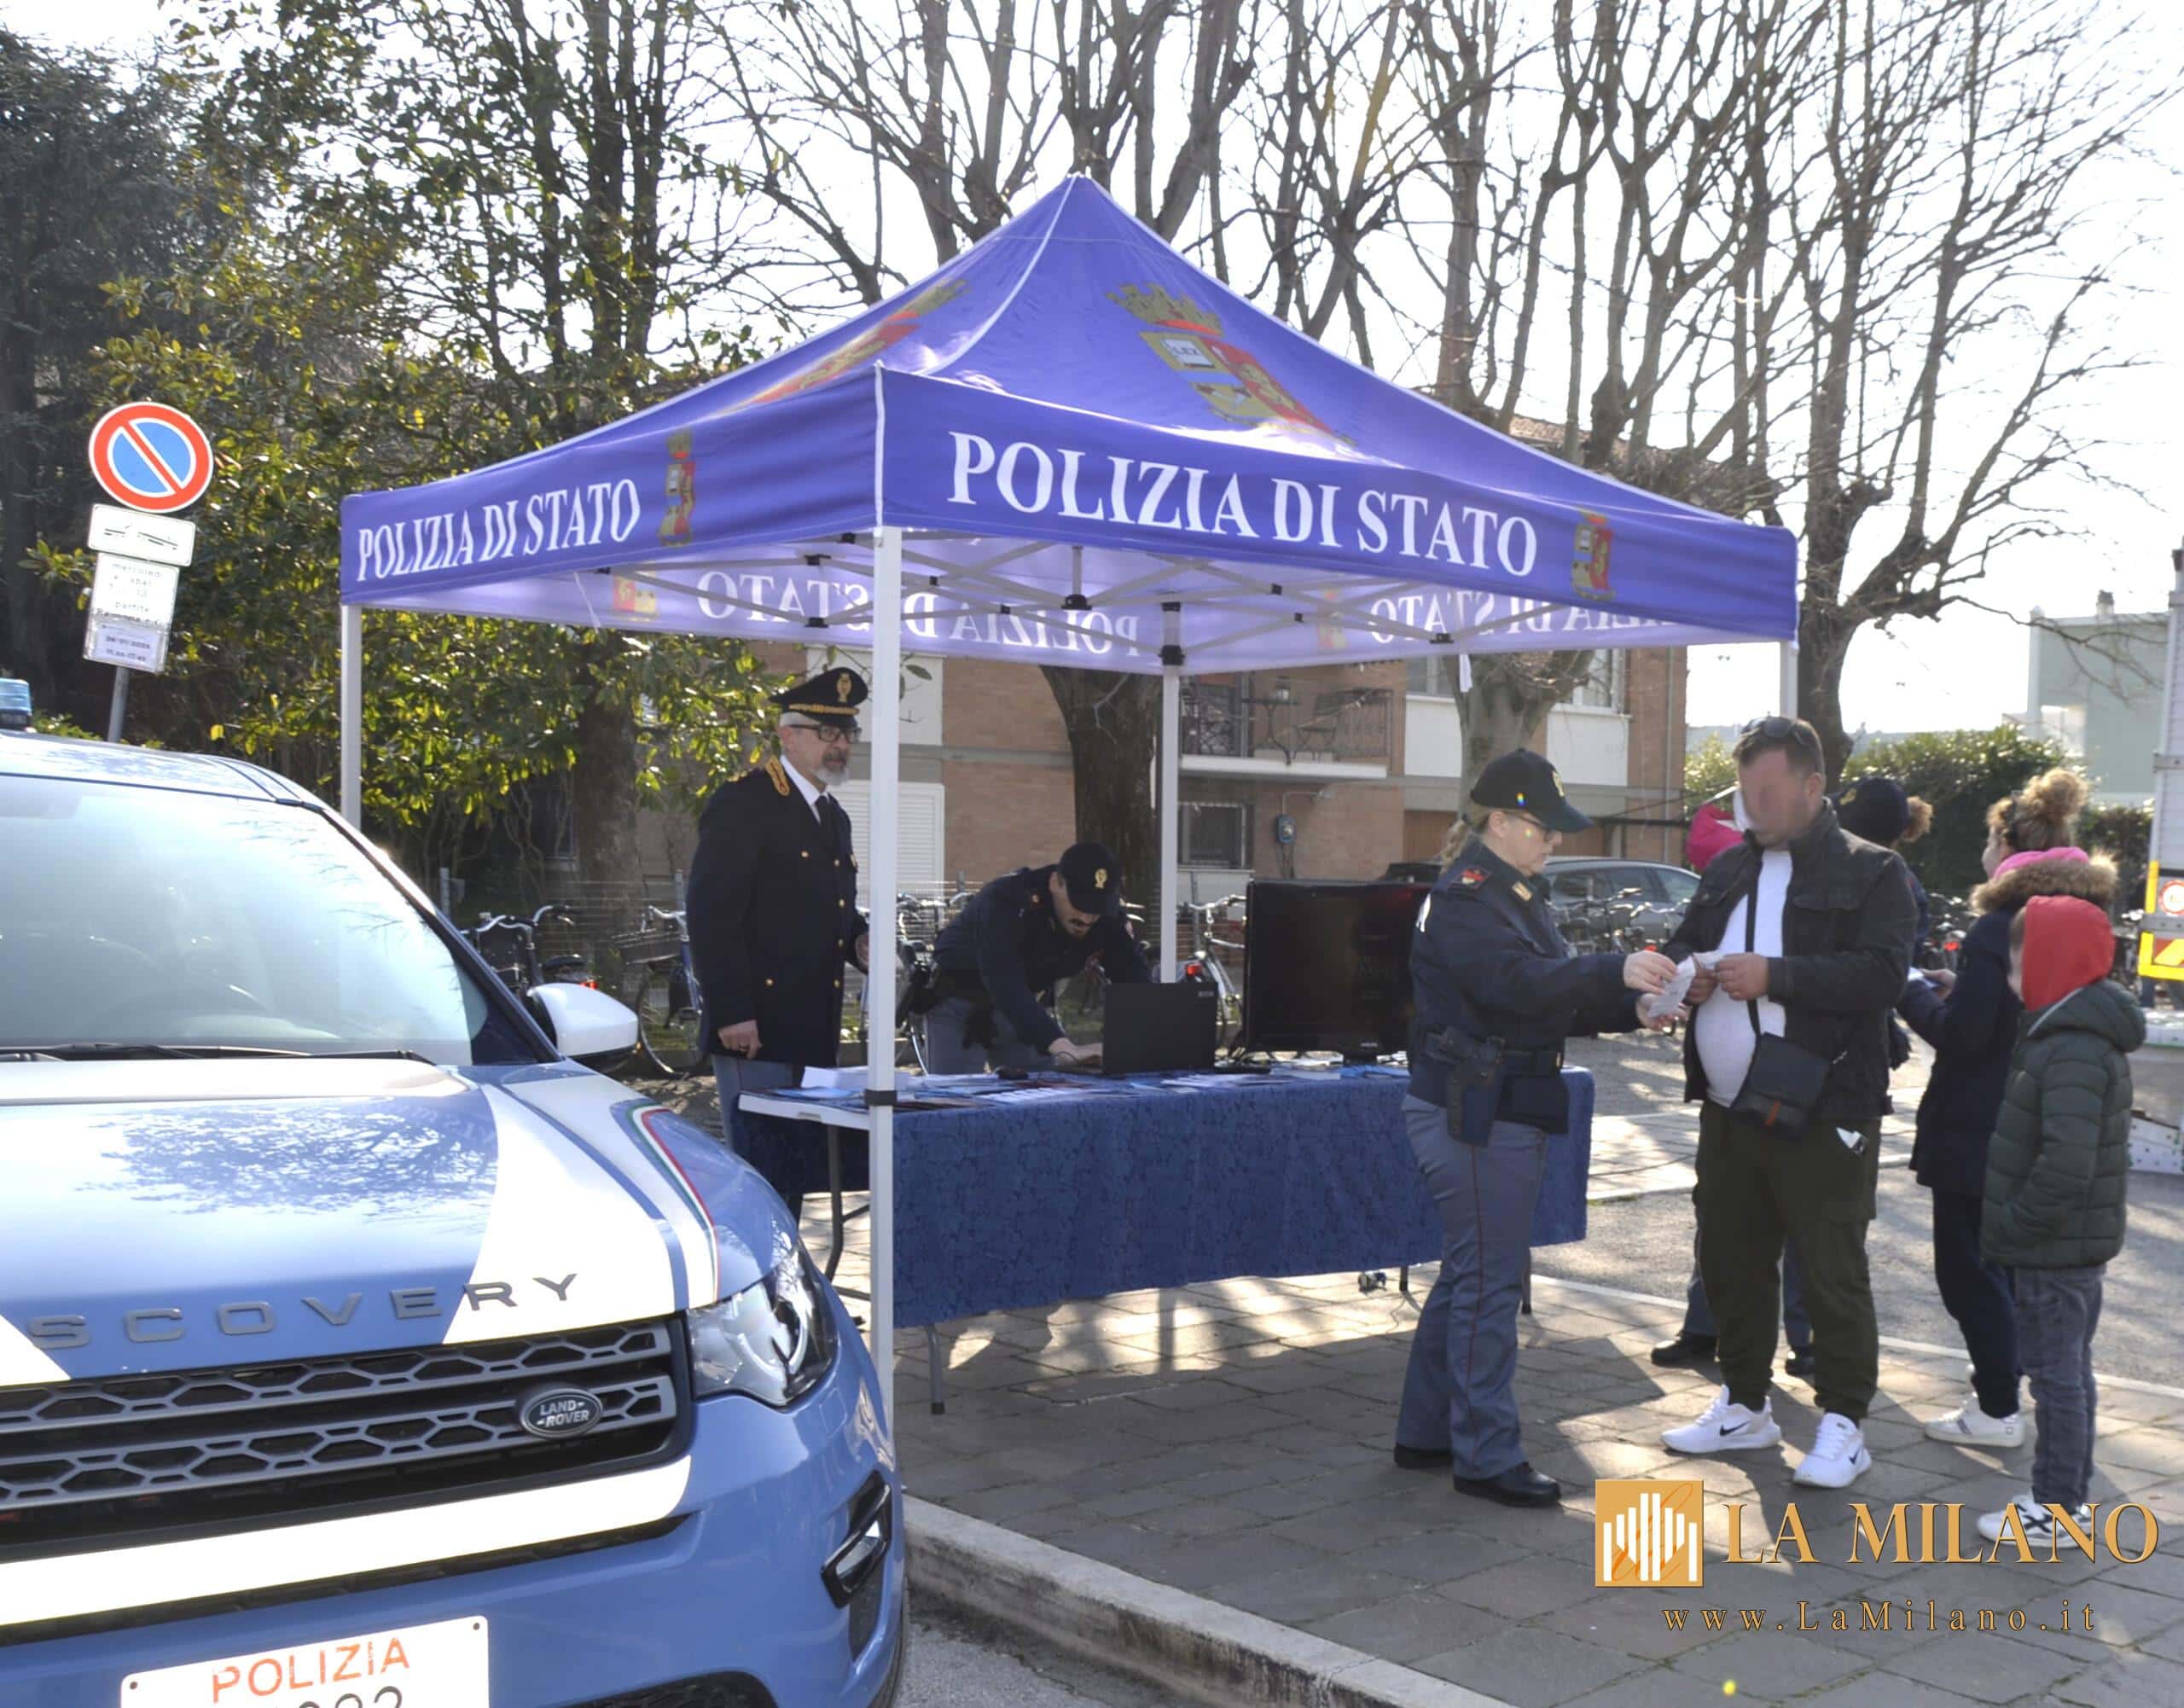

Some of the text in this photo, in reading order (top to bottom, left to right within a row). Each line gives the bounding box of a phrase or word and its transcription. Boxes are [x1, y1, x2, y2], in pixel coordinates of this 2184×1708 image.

[357, 479, 641, 582] POLIZIA DI STATO
[948, 431, 1537, 577] POLIZIA DI STATO
[212, 1638, 410, 1703] POLIZIA
